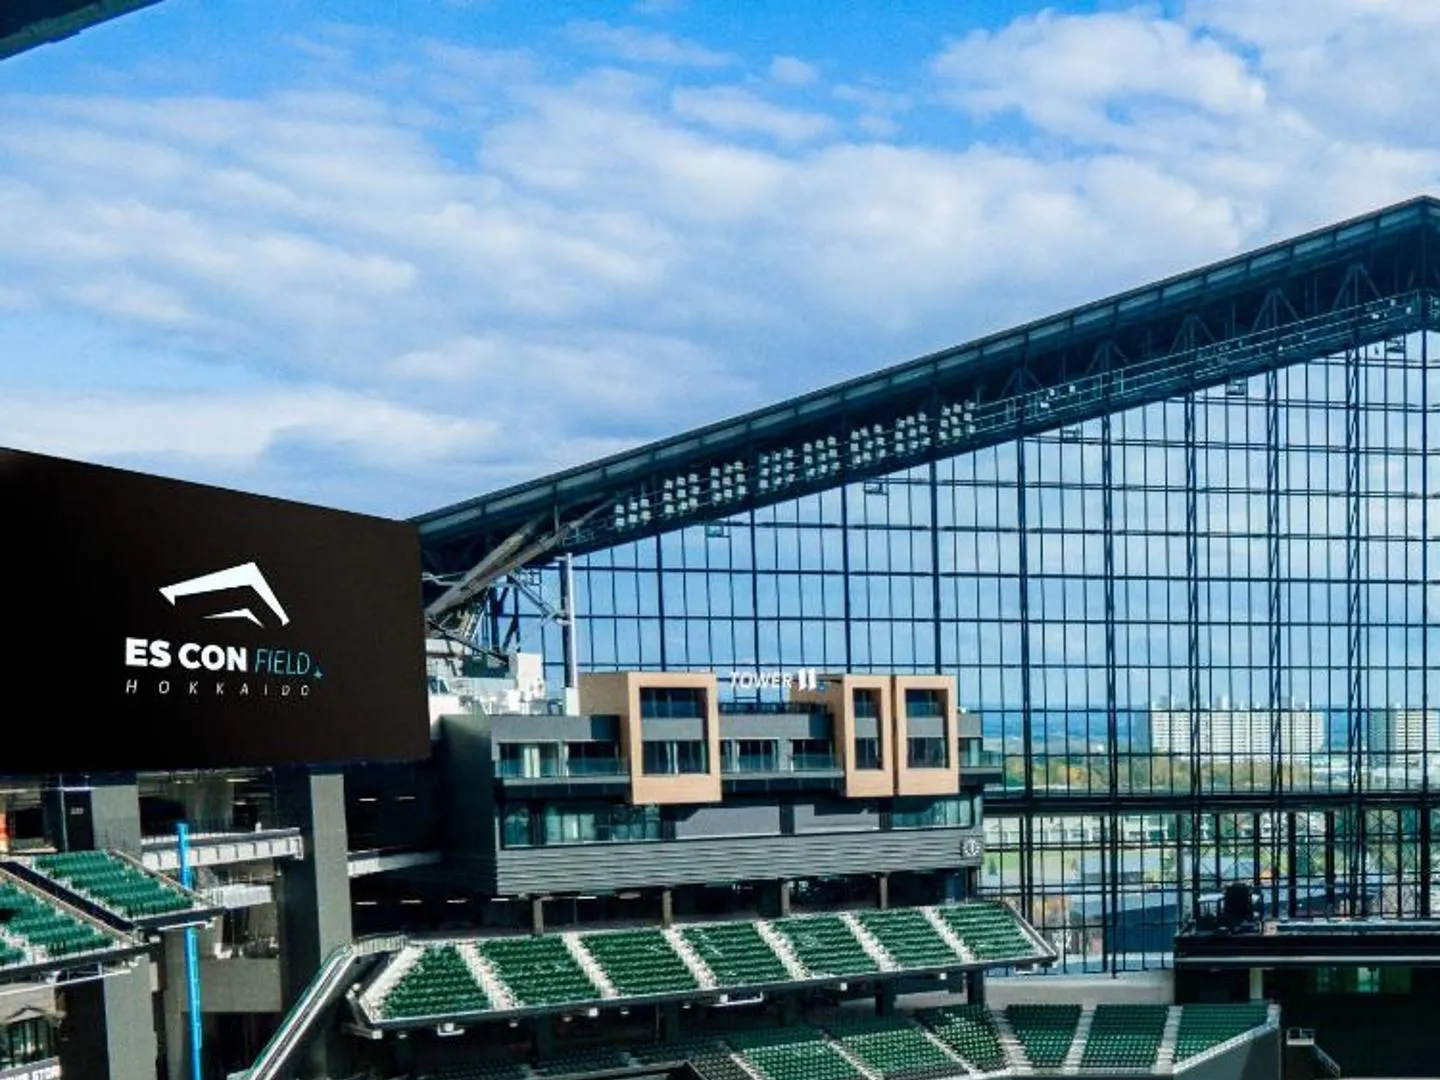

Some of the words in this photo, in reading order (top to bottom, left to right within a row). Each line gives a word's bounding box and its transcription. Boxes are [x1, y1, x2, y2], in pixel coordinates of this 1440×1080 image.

[125, 637, 172, 668] ES
[178, 642, 248, 672] CON
[255, 648, 310, 675] FIELD
[125, 679, 310, 697] HOKKAIDO
[729, 671, 792, 689] TOWER
[798, 667, 817, 691] 11
